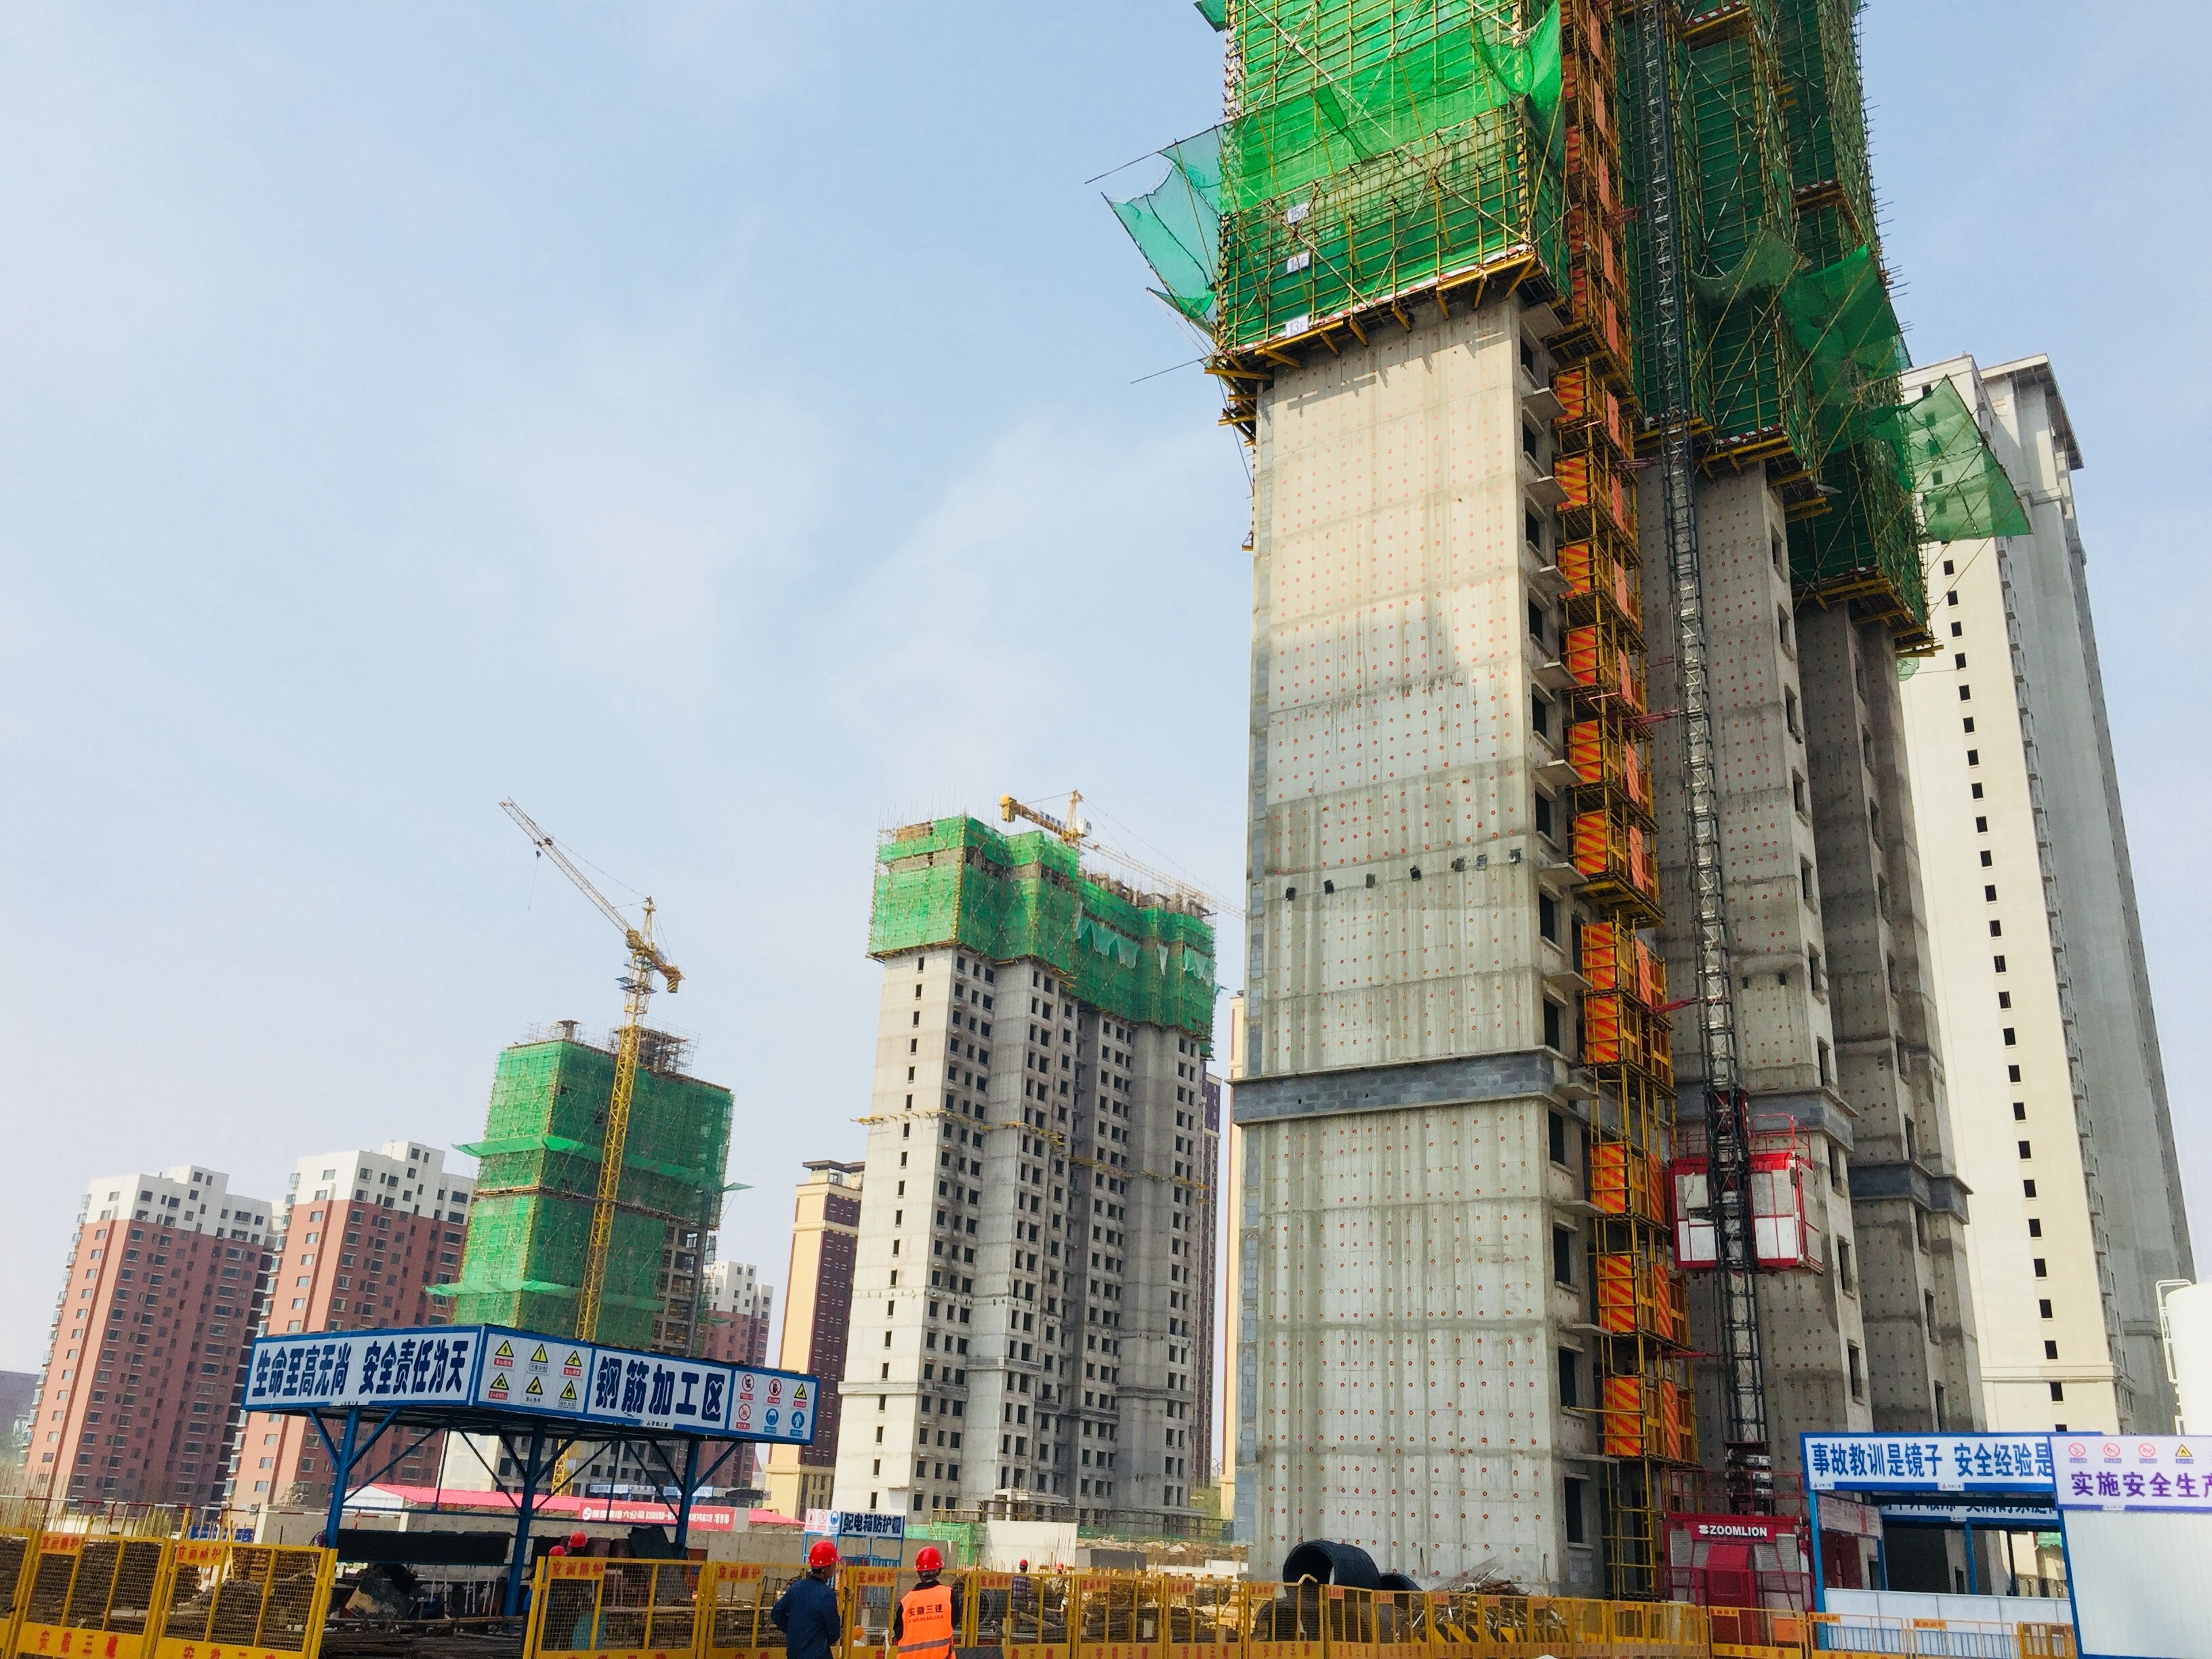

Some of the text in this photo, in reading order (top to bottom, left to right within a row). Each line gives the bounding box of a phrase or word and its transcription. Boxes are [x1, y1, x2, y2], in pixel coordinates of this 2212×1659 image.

[1290, 207, 1309, 221] 15F
[1290, 256, 1307, 270] 14F
[1288, 320, 1306, 335] 13F
[251, 1338, 468, 1397] 生命至高无尚 安全责任为天
[596, 1356, 725, 1422] 钢筋加工区
[1811, 1443, 2053, 1477] 事故教训是镜子 安全经验是
[1709, 1525, 1767, 1537] ZOOMLION
[552, 1561, 603, 1576] 立面防护
[908, 1603, 943, 1618] 安徽三建
